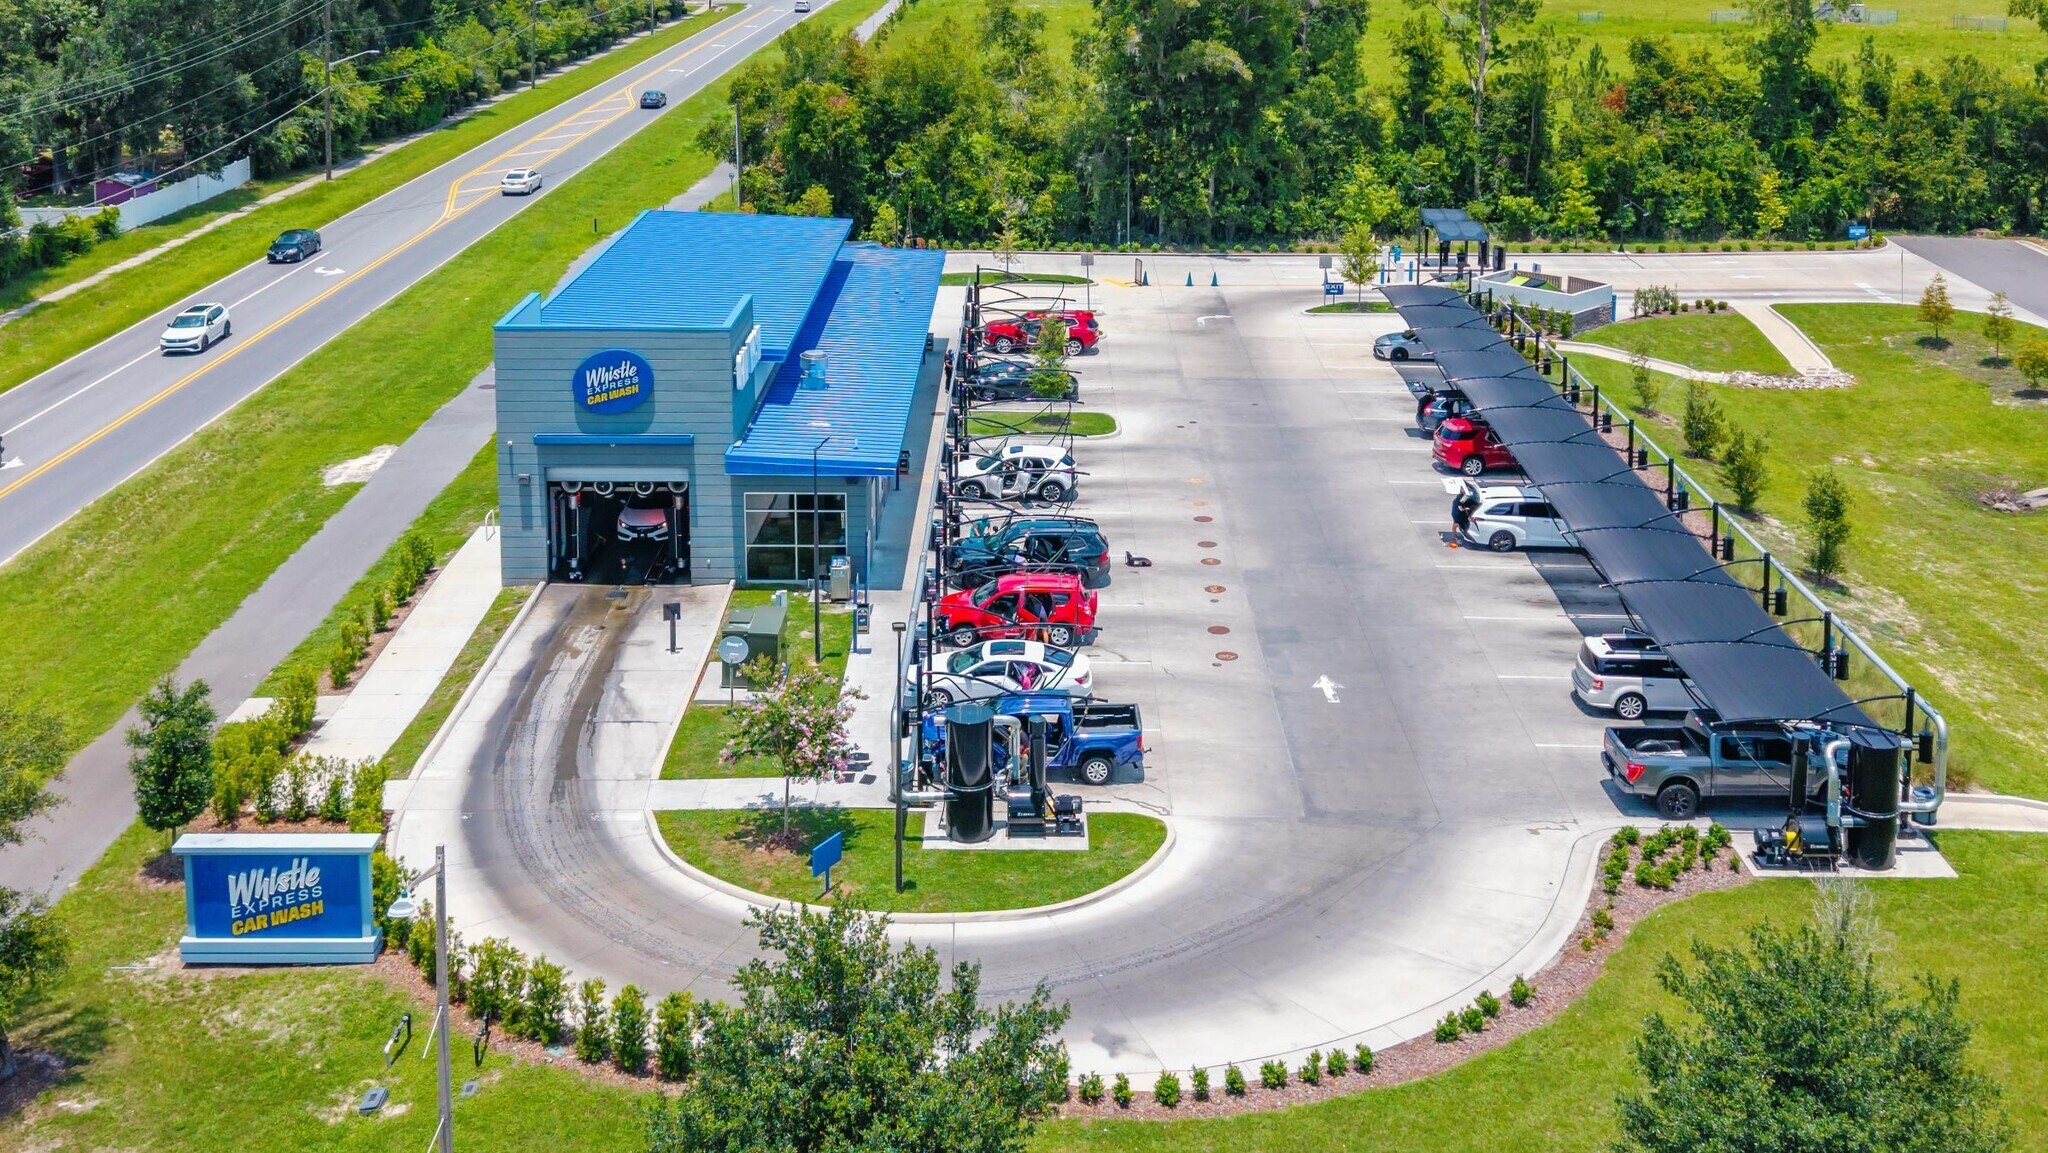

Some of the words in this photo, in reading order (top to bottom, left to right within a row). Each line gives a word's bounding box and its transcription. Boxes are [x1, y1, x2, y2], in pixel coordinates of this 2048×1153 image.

[586, 360, 637, 388] Whistle
[587, 376, 639, 396] EXPRESS
[587, 393, 608, 405] CAR
[609, 384, 639, 400] WASH
[228, 857, 321, 906] Whistle
[231, 886, 323, 919] EXPRESS
[232, 915, 268, 936] CAR
[271, 900, 324, 926] WASH
